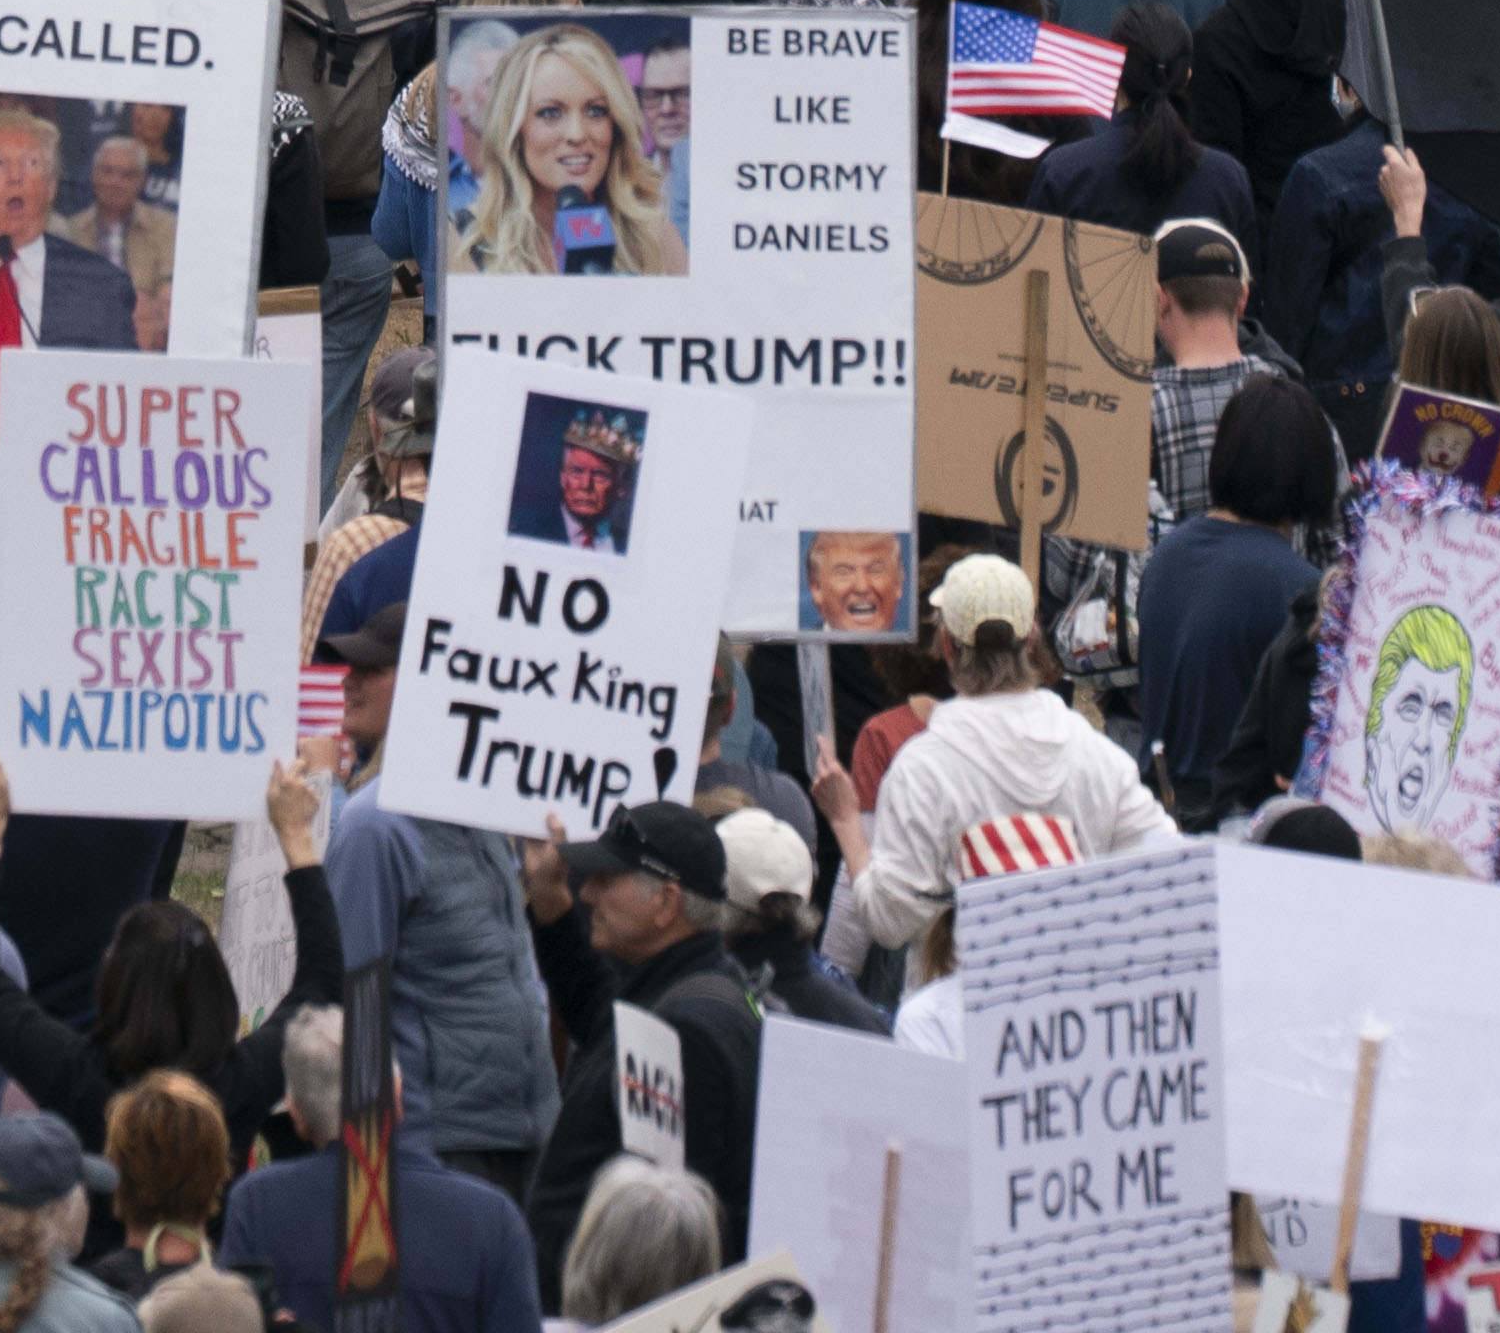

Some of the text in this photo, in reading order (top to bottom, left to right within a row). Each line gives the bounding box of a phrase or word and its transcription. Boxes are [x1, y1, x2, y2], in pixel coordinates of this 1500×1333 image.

[734, 161, 886, 195] STORMY
[731, 221, 891, 254] DANIELS
[65, 383, 248, 448] SUPER
[445, 702, 679, 836] Trump!
[997, 988, 1198, 1076] AND THEN
